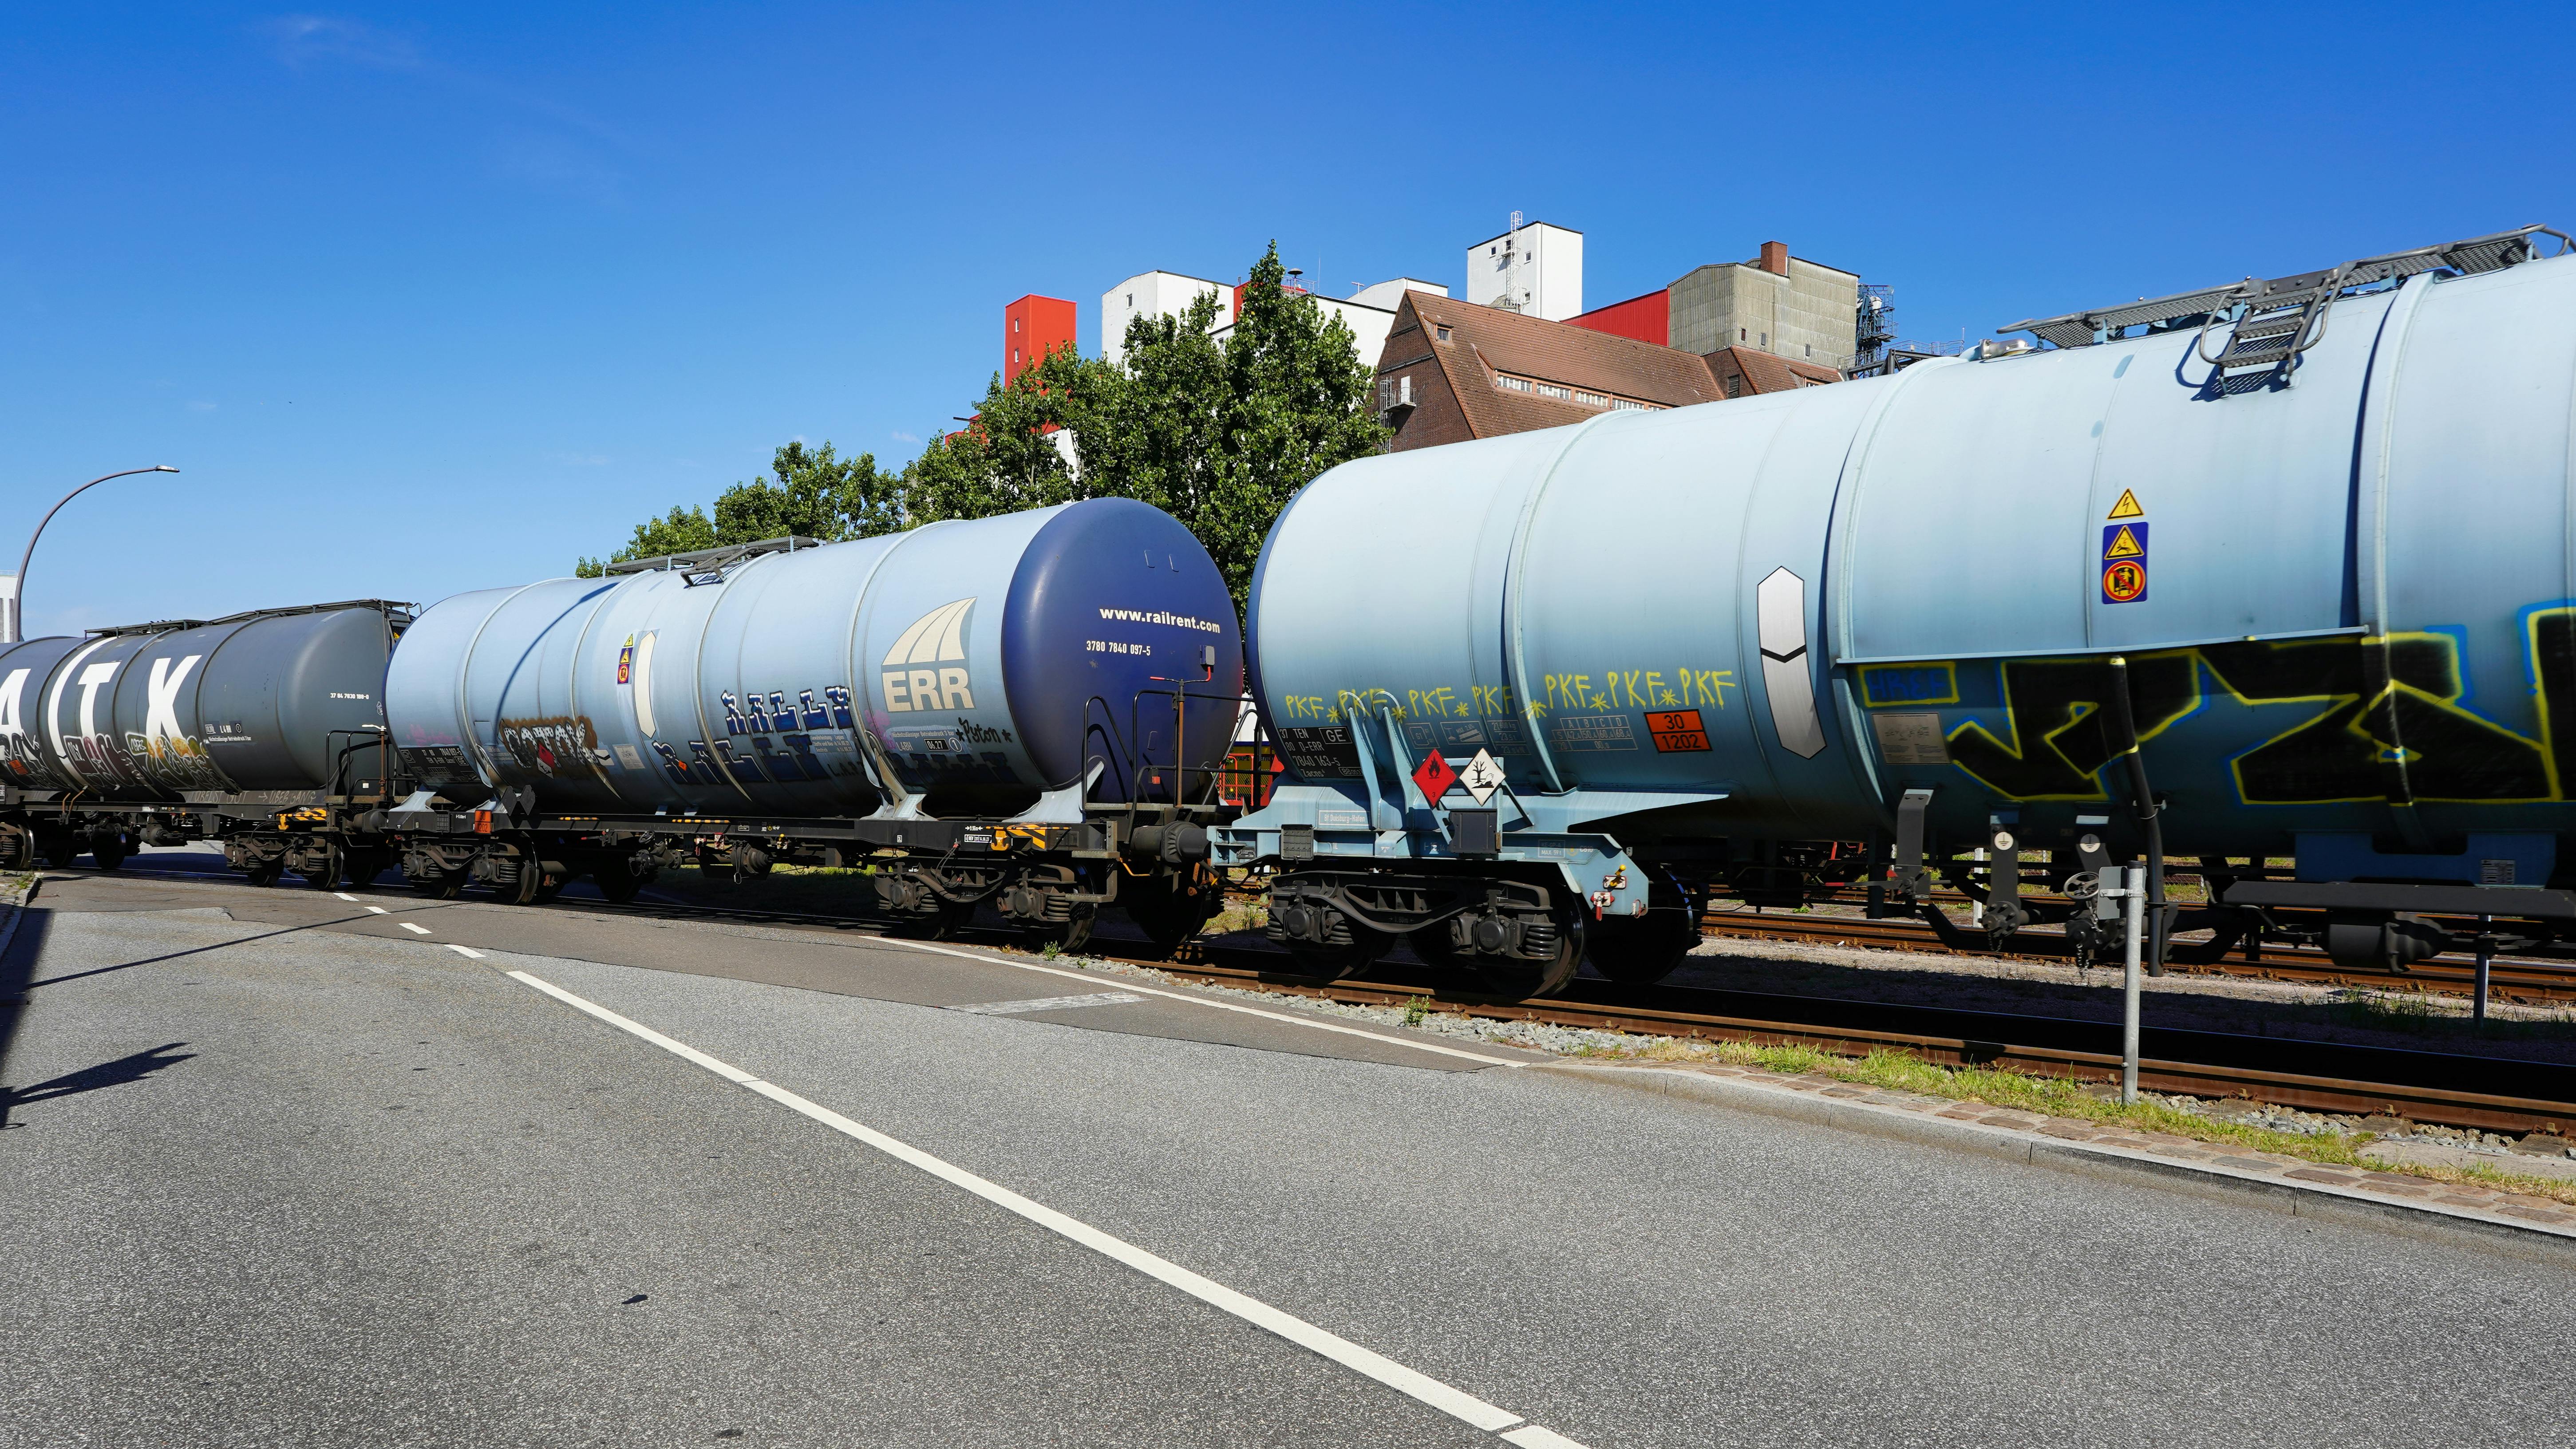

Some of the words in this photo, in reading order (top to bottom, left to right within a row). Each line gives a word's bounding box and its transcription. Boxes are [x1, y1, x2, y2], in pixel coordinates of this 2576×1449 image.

[1099, 608, 1221, 634] www.railrent.com
[1086, 640, 1106, 652] 3780
[1109, 642, 1127, 654] 7840
[1130, 644, 1151, 656] 097-5
[882, 667, 975, 712] ERR
[1569, 719, 1574, 729] A
[1584, 719, 1590, 728] B
[1599, 718, 1605, 727] C
[1615, 717, 1622, 726] D
[1664, 714, 1684, 730] 30
[1279, 728, 1288, 738] 37
[1292, 728, 1309, 738] TEN
[1325, 729, 1347, 742] GE
[1557, 730, 1563, 740] S
[896, 742, 914, 751] L4BH
[926, 740, 944, 750] 06.27
[1285, 742, 1296, 751] 80
[1298, 741, 1325, 752] D-ERR
[1662, 734, 1702, 750] 1202
[1292, 755, 1316, 766] 7840
[1314, 755, 1341, 767] 163-5
[480, 812, 486, 821] 30
[1330, 814, 1365, 824] Duisburg-Hafen
